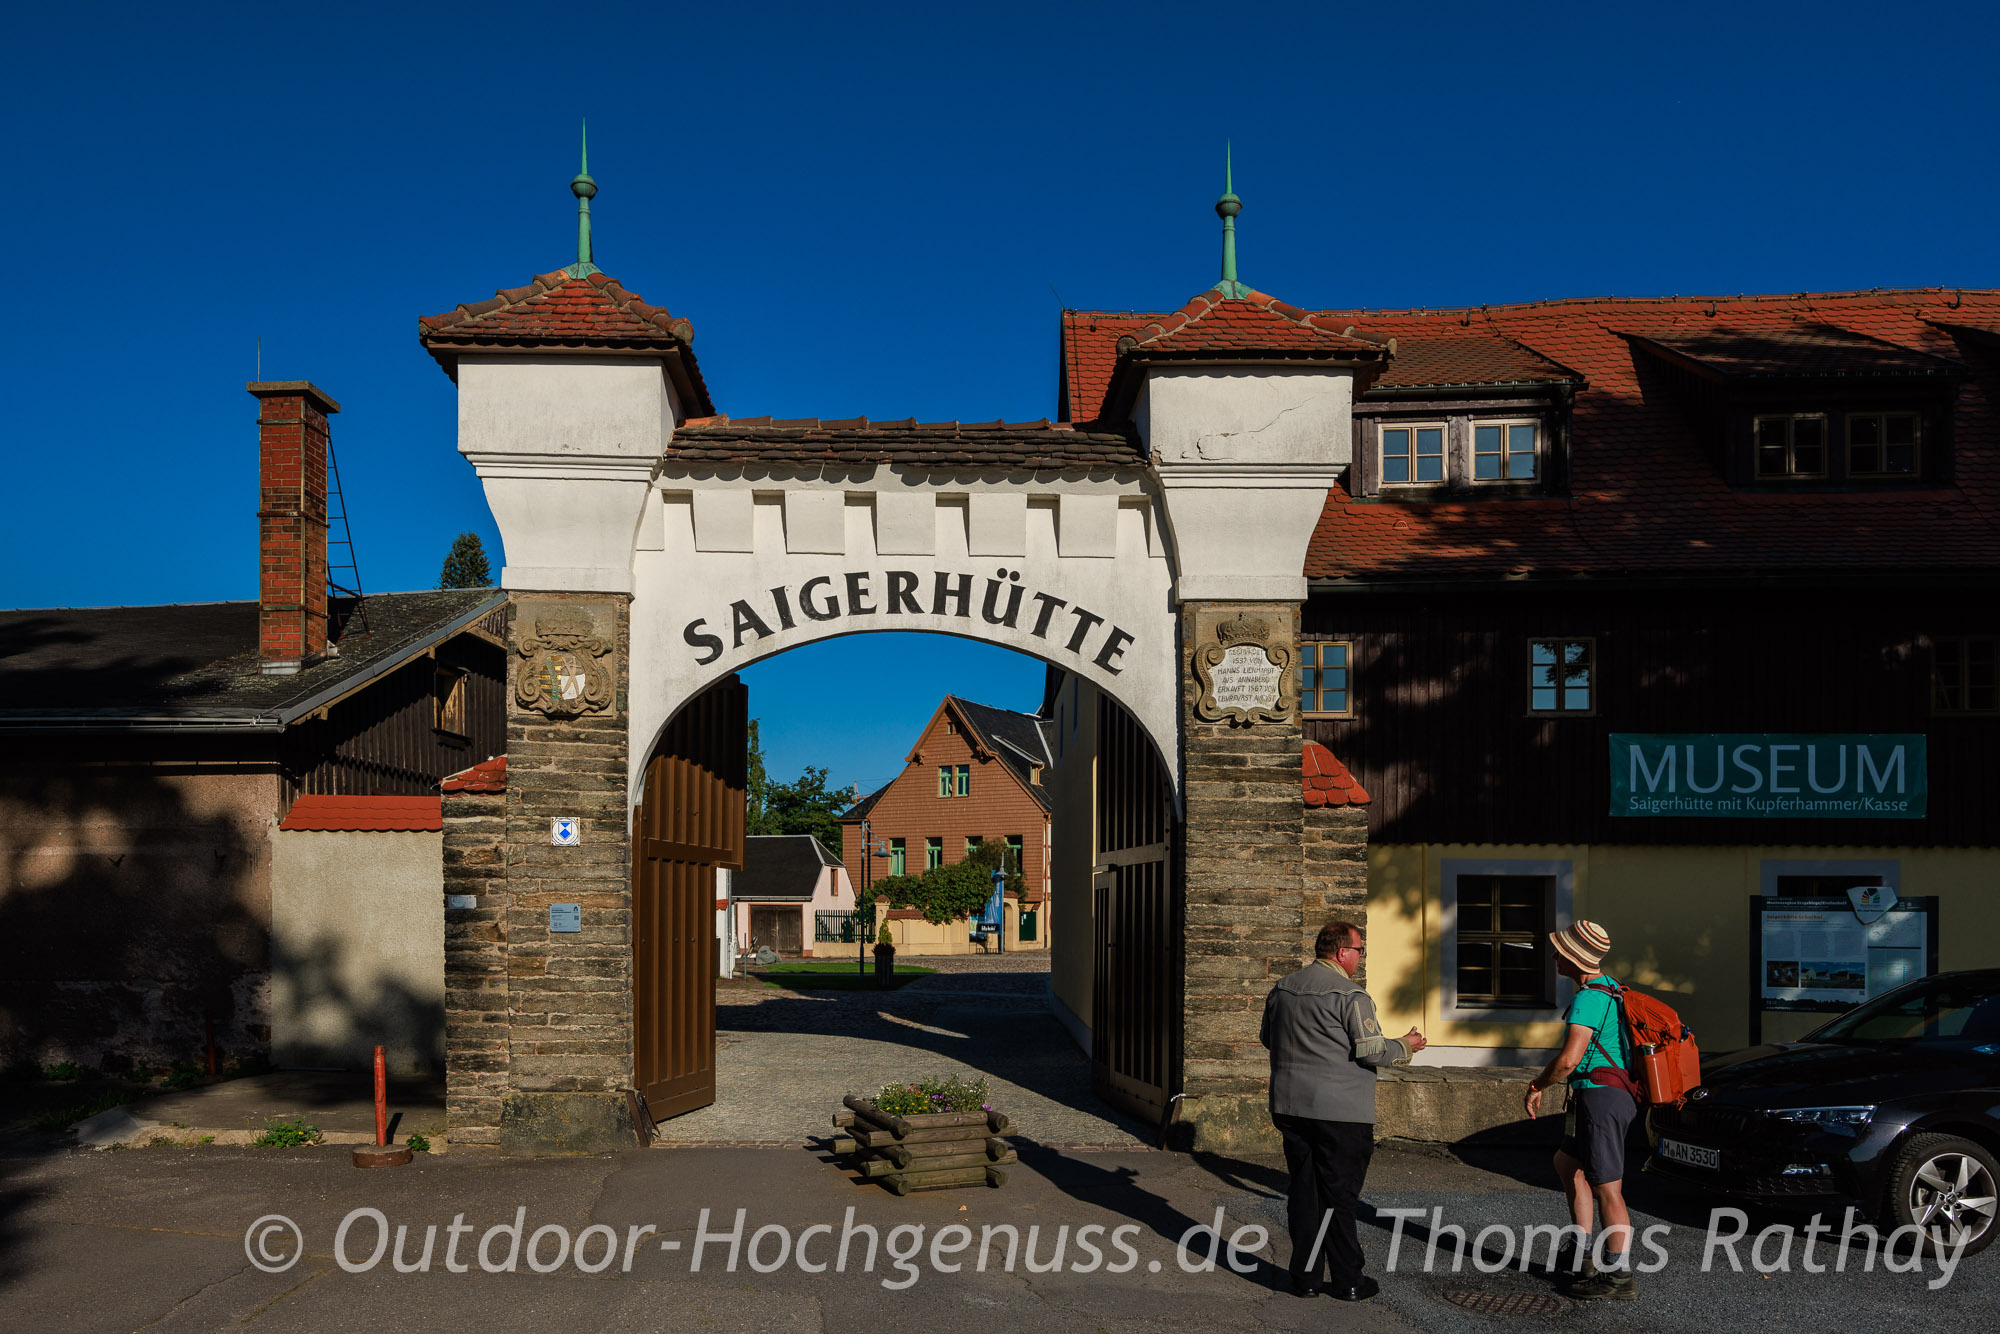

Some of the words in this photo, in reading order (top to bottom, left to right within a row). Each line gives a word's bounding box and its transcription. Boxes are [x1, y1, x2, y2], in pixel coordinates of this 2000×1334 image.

[683, 567, 1136, 677] SAIGERHÜTTE
[1629, 744, 1905, 793] MUSEUM
[1630, 796, 1713, 813] Saigerhütte
[1717, 797, 1742, 810] mit
[1746, 797, 1908, 814] Kupferhammer/Kasse
[1664, 1141, 1670, 1155] M
[1676, 1144, 1688, 1159] AN
[1690, 1147, 1716, 1166] 3530
